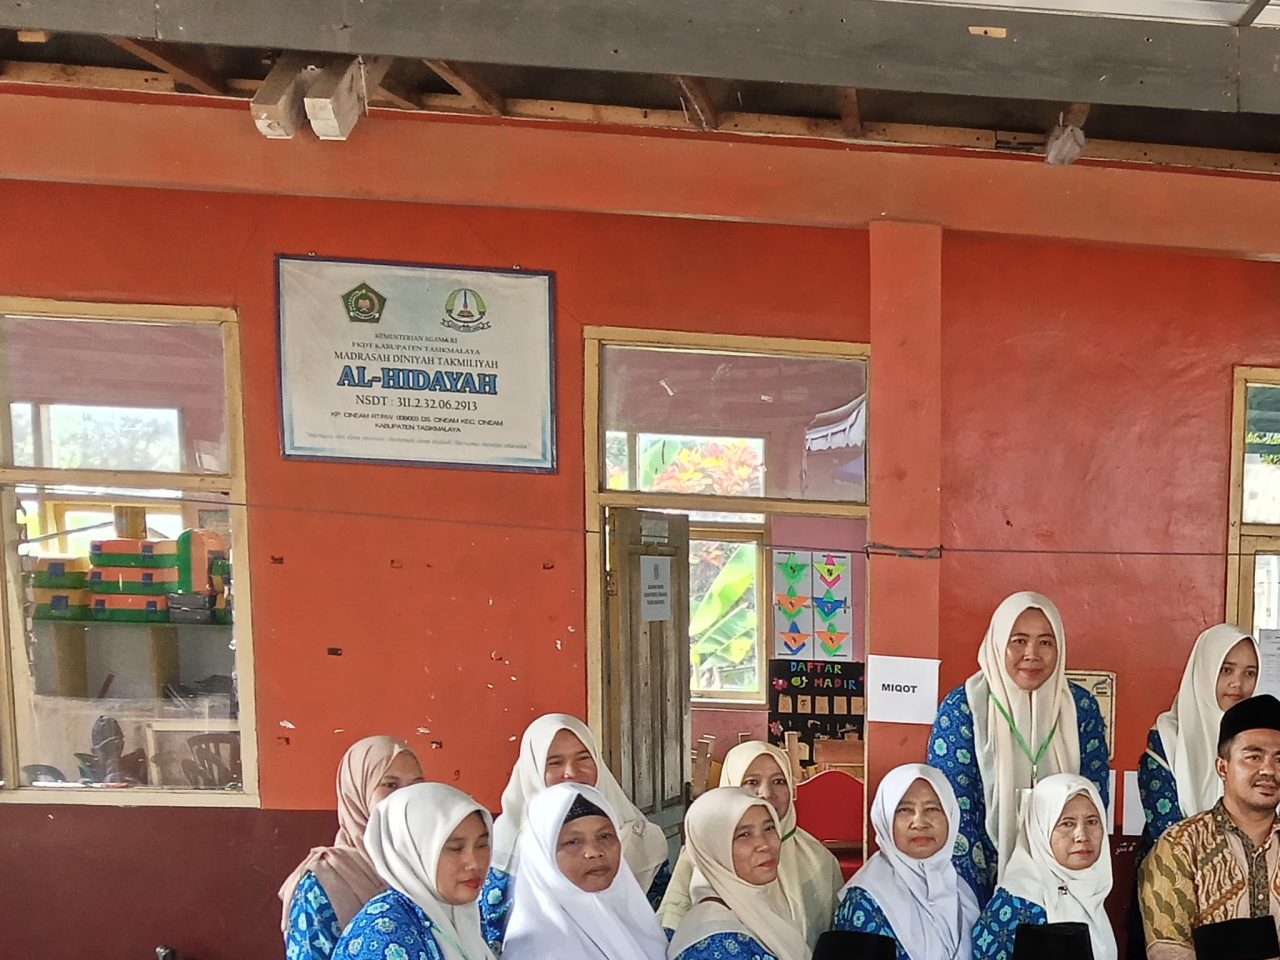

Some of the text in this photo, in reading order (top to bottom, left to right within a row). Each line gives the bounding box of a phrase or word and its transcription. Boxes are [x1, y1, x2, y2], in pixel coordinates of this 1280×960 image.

[375, 333, 423, 342] KEMENTERIAN
[375, 343, 422, 352] KABUPATEN
[425, 346, 480, 355] TASIKMALAYA
[334, 351, 498, 368] MADRASAH DINIYAH TAKMILIYAH
[336, 364, 498, 394] AL-HIDAYAH
[356, 394, 388, 406] NSDT
[790, 662, 842, 674] DAFTAR
[814, 678, 856, 690] HADIR
[881, 683, 918, 694] MIQOT
